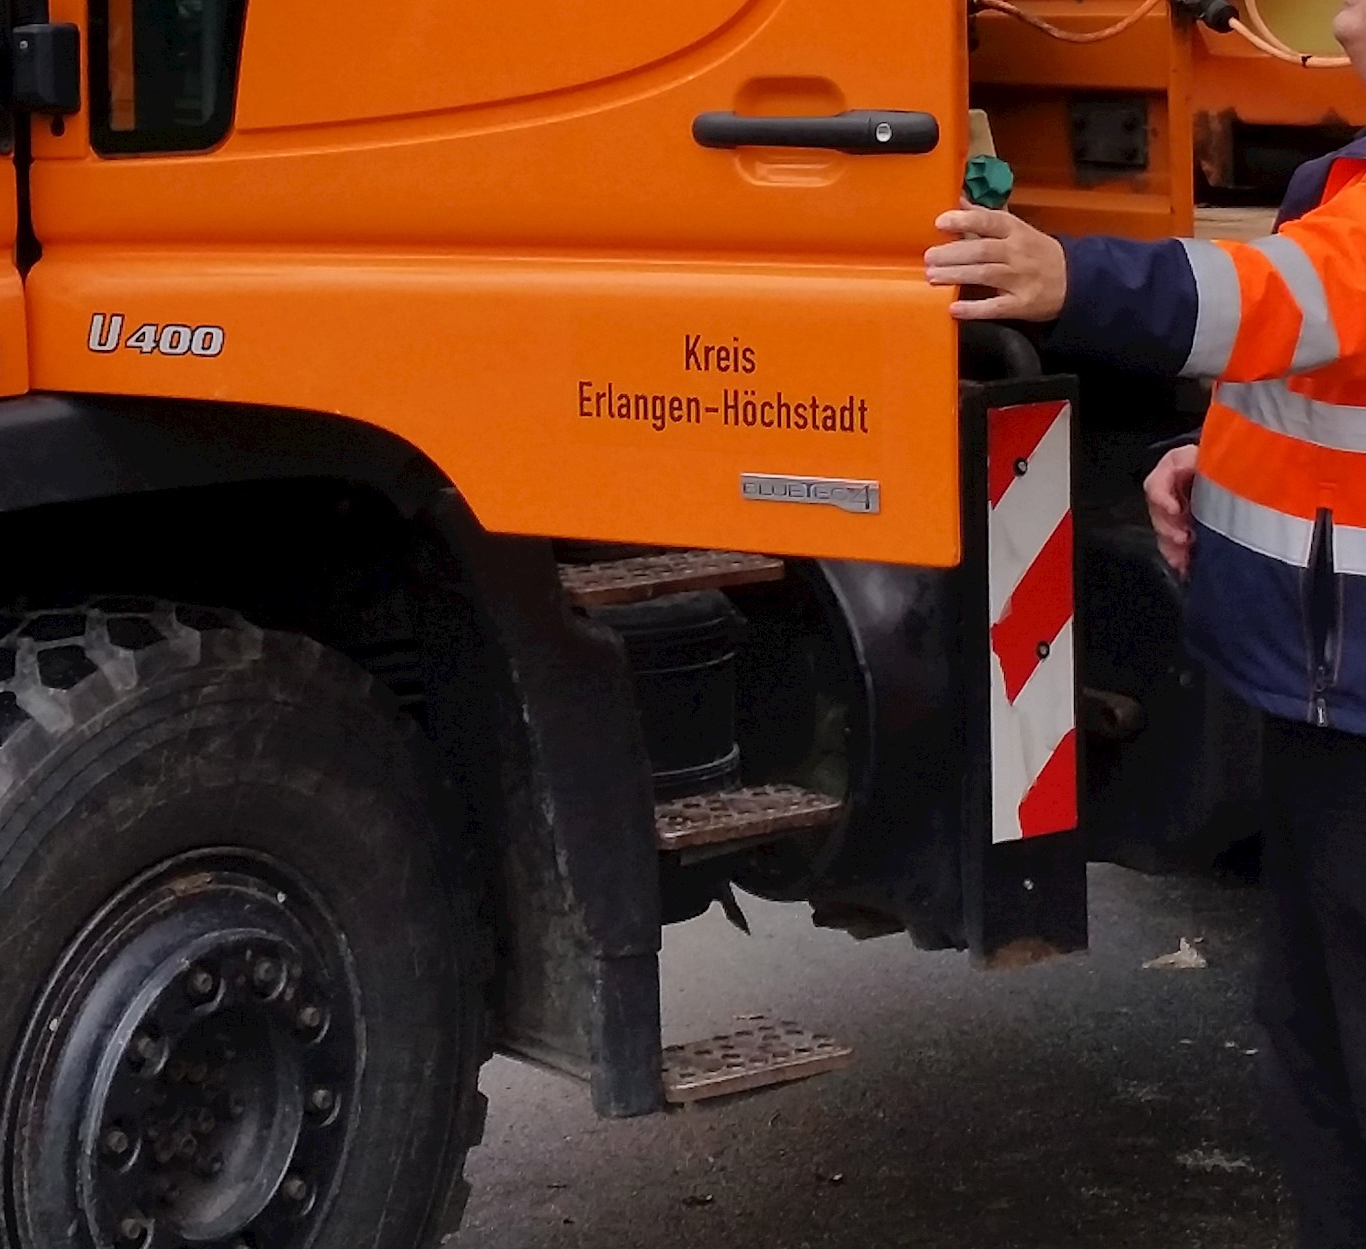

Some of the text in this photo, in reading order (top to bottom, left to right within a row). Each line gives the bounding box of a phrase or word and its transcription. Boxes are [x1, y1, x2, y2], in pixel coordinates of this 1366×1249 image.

[88, 313, 224, 357] U 400
[684, 334, 757, 374] Kreis
[578, 380, 869, 434] Erlangen-Höchstadt
